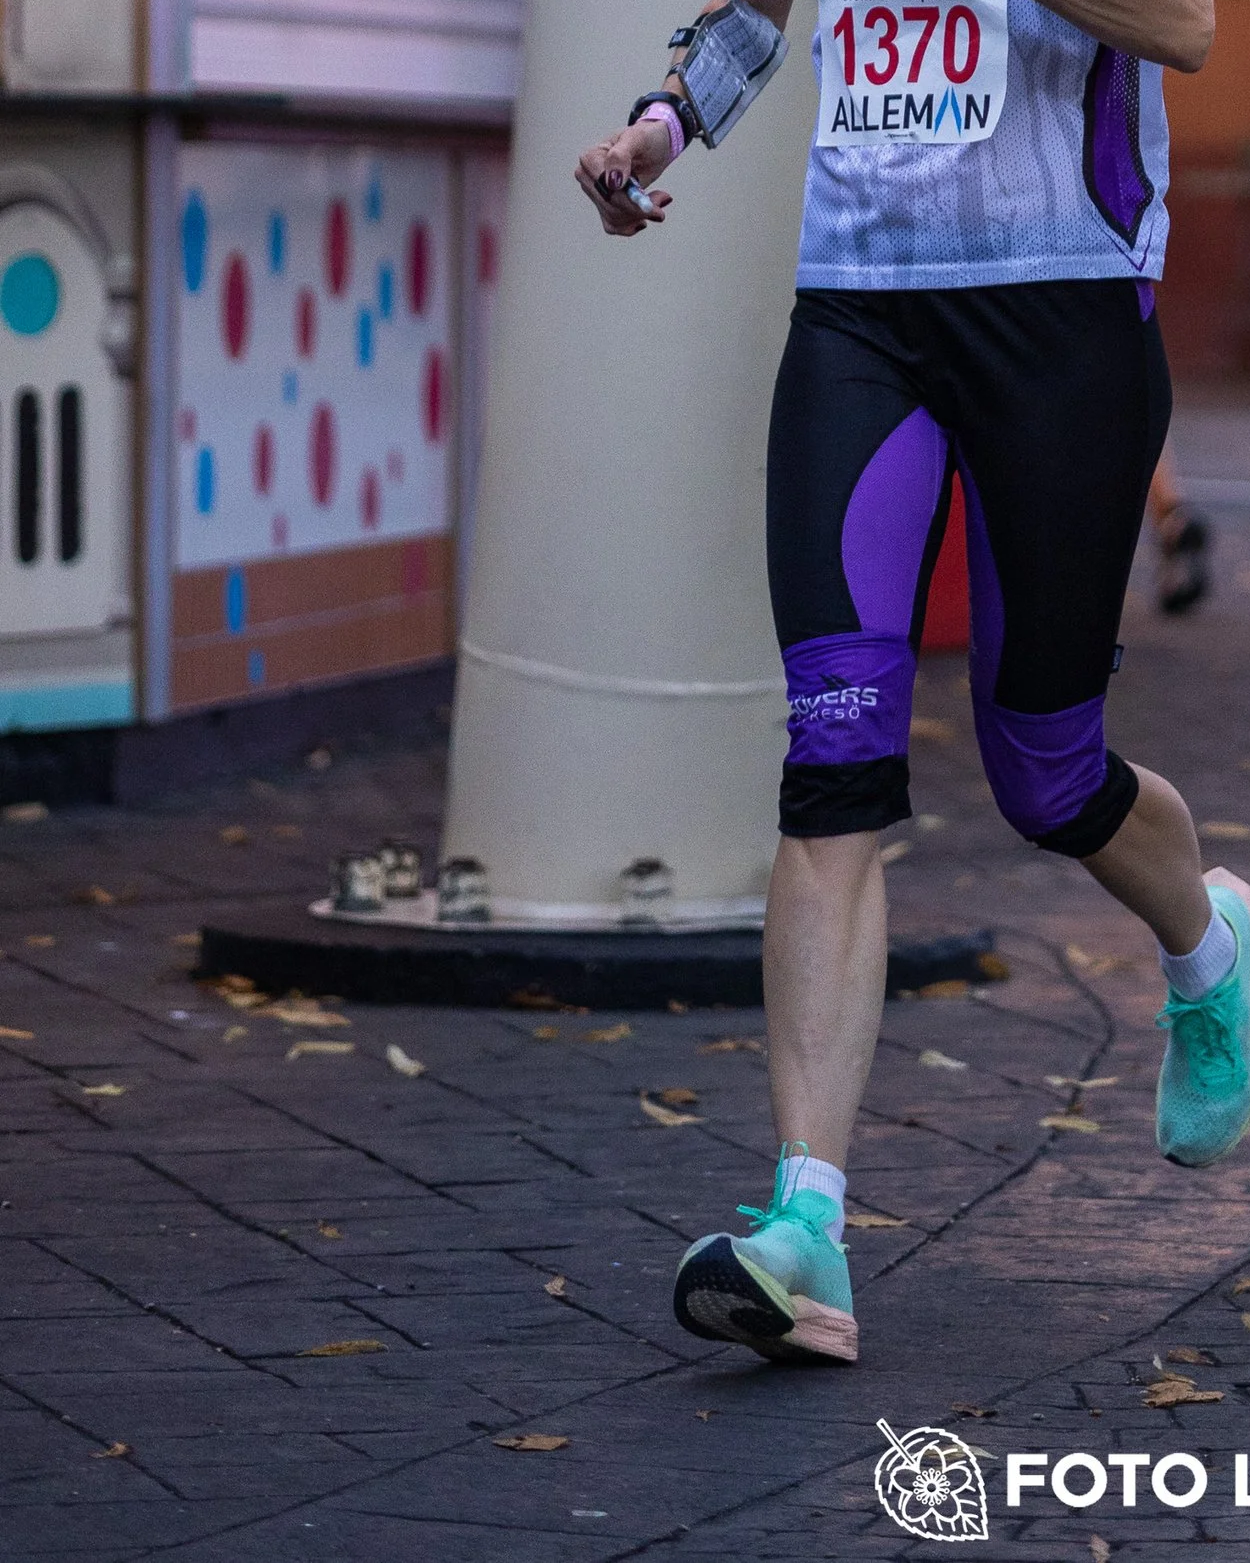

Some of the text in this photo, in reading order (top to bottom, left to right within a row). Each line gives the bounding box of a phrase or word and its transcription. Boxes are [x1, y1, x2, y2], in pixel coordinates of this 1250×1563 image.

[833, 5, 980, 86] 1370
[831, 87, 991, 138] ALLEMAN
[796, 704, 861, 726] RESÖ
